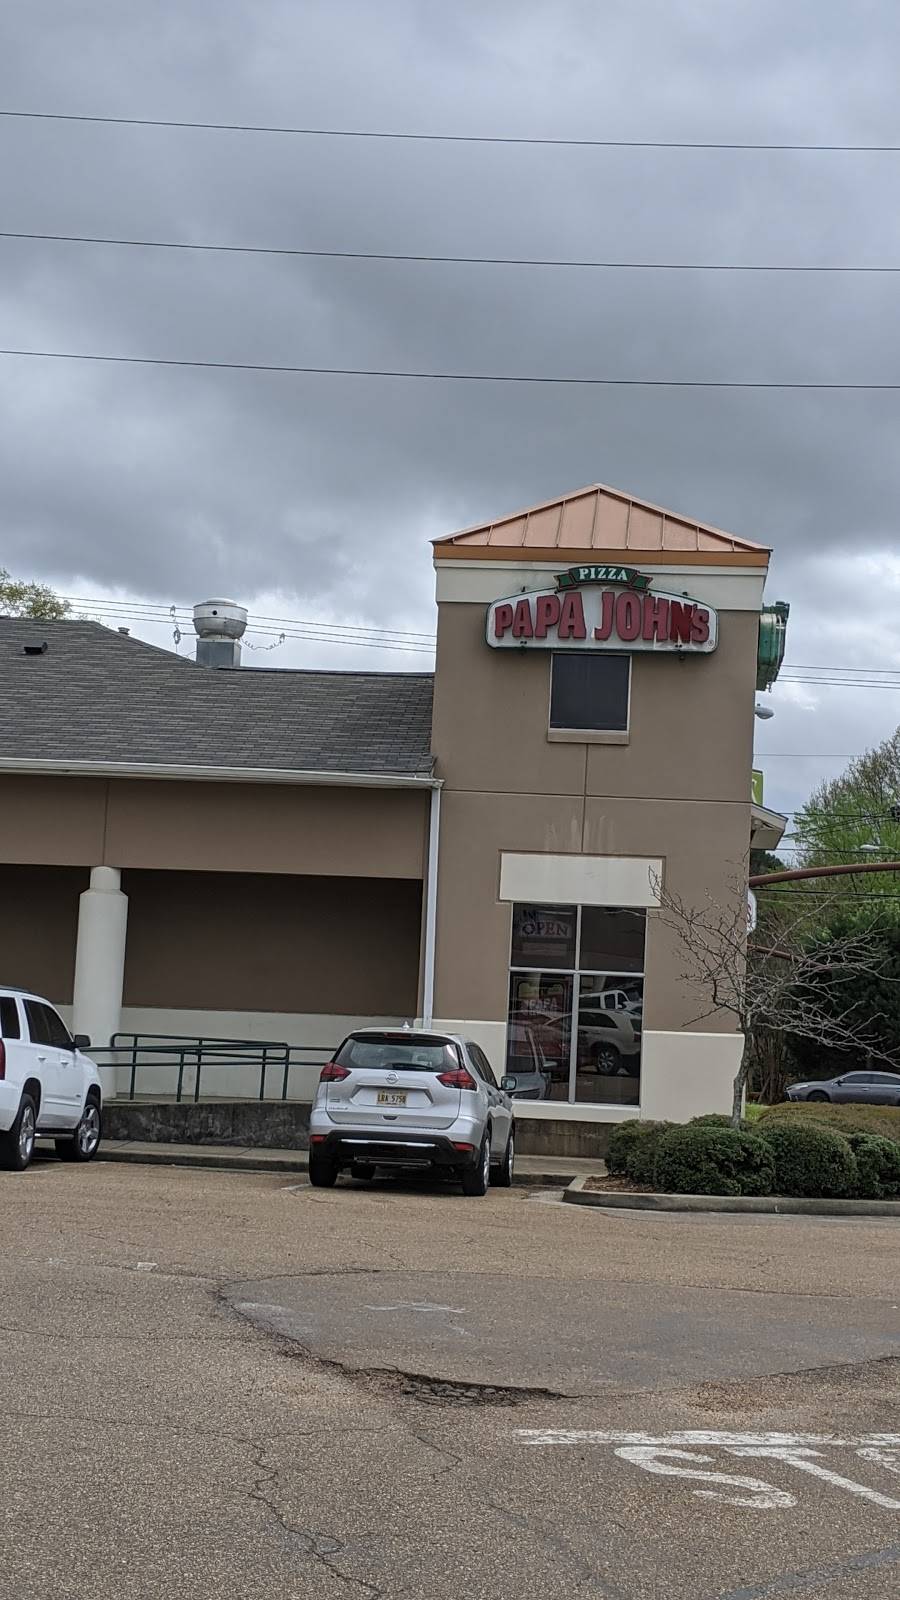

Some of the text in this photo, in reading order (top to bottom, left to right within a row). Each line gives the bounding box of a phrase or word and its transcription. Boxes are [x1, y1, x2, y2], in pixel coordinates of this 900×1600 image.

[578, 567, 628, 581] PIZZA
[494, 591, 710, 643] PAPA JOHN'S
[521, 921, 568, 935] OPEN
